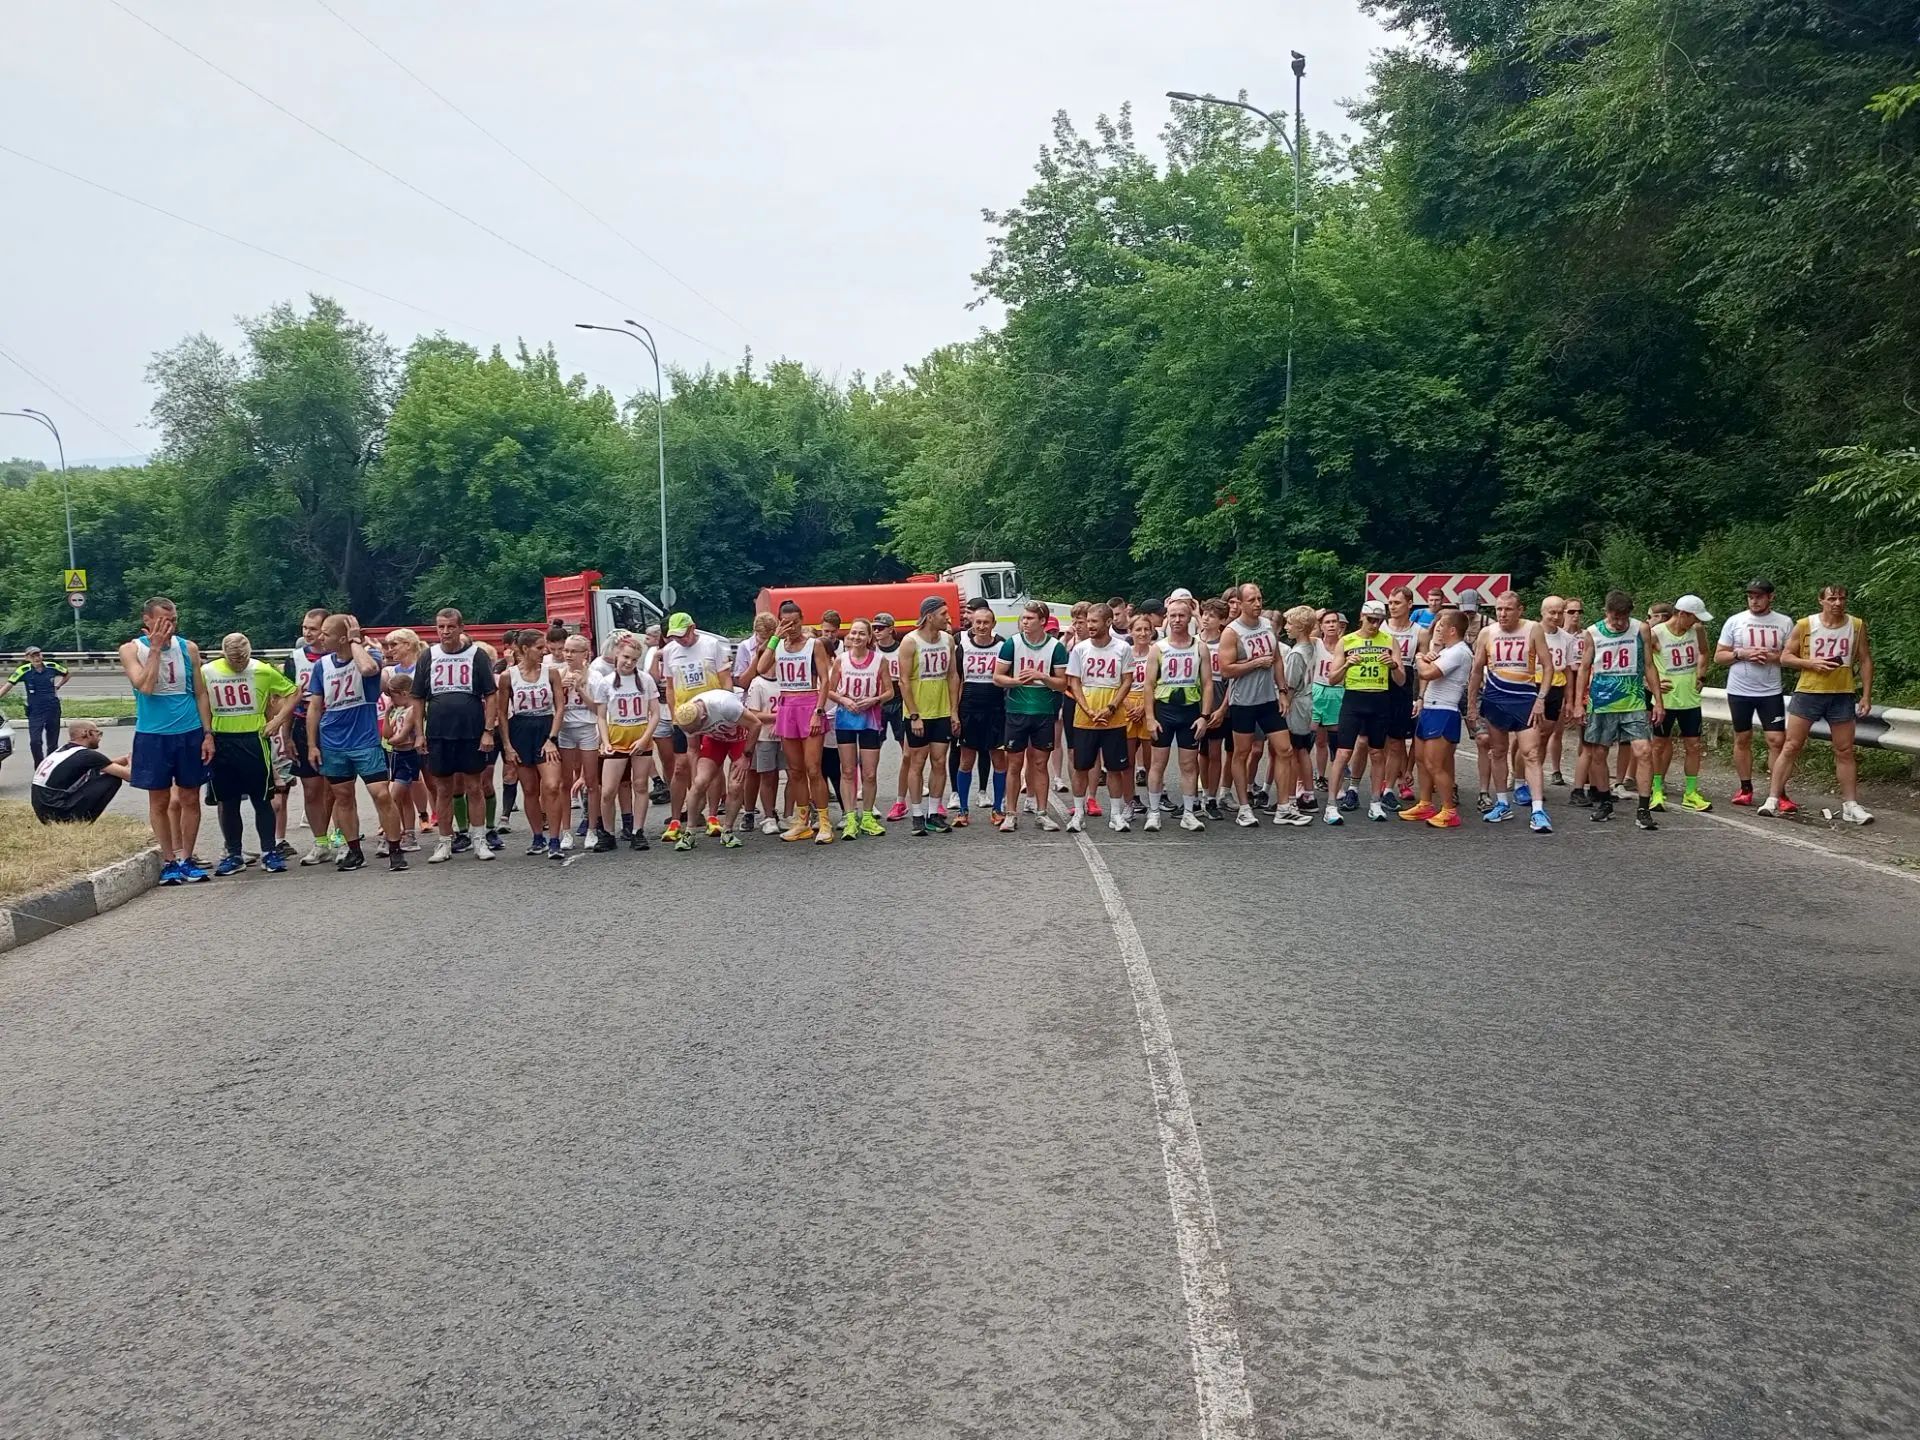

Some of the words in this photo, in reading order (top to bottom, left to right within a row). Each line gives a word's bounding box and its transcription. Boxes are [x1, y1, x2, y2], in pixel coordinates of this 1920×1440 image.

[1248, 635, 1272, 658] 231
[1748, 628, 1778, 648] 111
[1815, 637, 1849, 658] 279
[1495, 640, 1525, 662] 177
[1548, 648, 1562, 666] 3
[1603, 648, 1628, 670] 96
[1672, 646, 1694, 666] 89
[780, 662, 806, 682] 104
[925, 652, 948, 672] 178
[967, 655, 996, 674] 254
[1086, 657, 1116, 678] 224
[1168, 658, 1192, 678] 98
[1212, 654, 1220, 672] 8
[1360, 666, 1378, 678] 215
[434, 664, 470, 686] 218
[684, 671, 704, 683] 1501
[214, 684, 251, 706] 186
[330, 674, 354, 702] 72
[845, 677, 870, 698] 181
[518, 688, 550, 710] 212
[618, 696, 642, 717] 90
